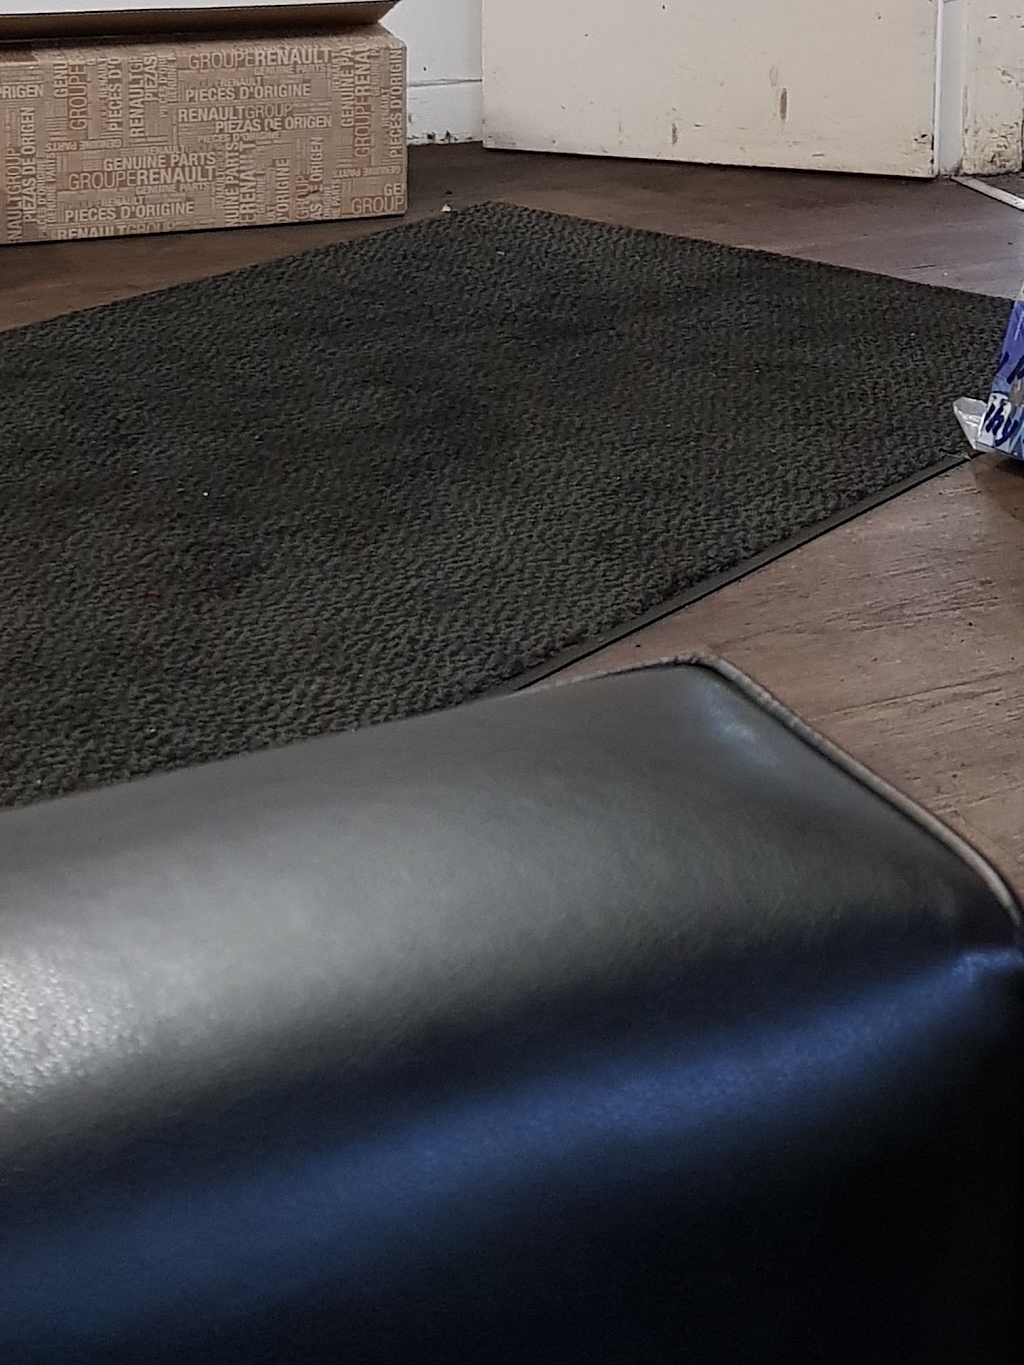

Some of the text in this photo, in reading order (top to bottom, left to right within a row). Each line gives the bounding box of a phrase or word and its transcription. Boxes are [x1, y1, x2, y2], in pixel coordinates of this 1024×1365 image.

[109, 84, 123, 131] PIECES
[185, 84, 311, 102] PIECES D'ORIGINE
[341, 69, 354, 128] GENUINE
[21, 107, 36, 155] ORIGEN
[215, 120, 261, 133] PIEZAS
[285, 116, 332, 130] ORIGEN
[389, 113, 402, 158] PIECES
[68, 165, 216, 191] GROUPERENAULT
[104, 152, 216, 171] GENUINE PARTS
[225, 141, 239, 184] PARTS
[309, 137, 323, 181] ORIGEN
[22, 177, 37, 223] PIEZAS
[65, 201, 195, 223] PIECES D'ORIGINE
